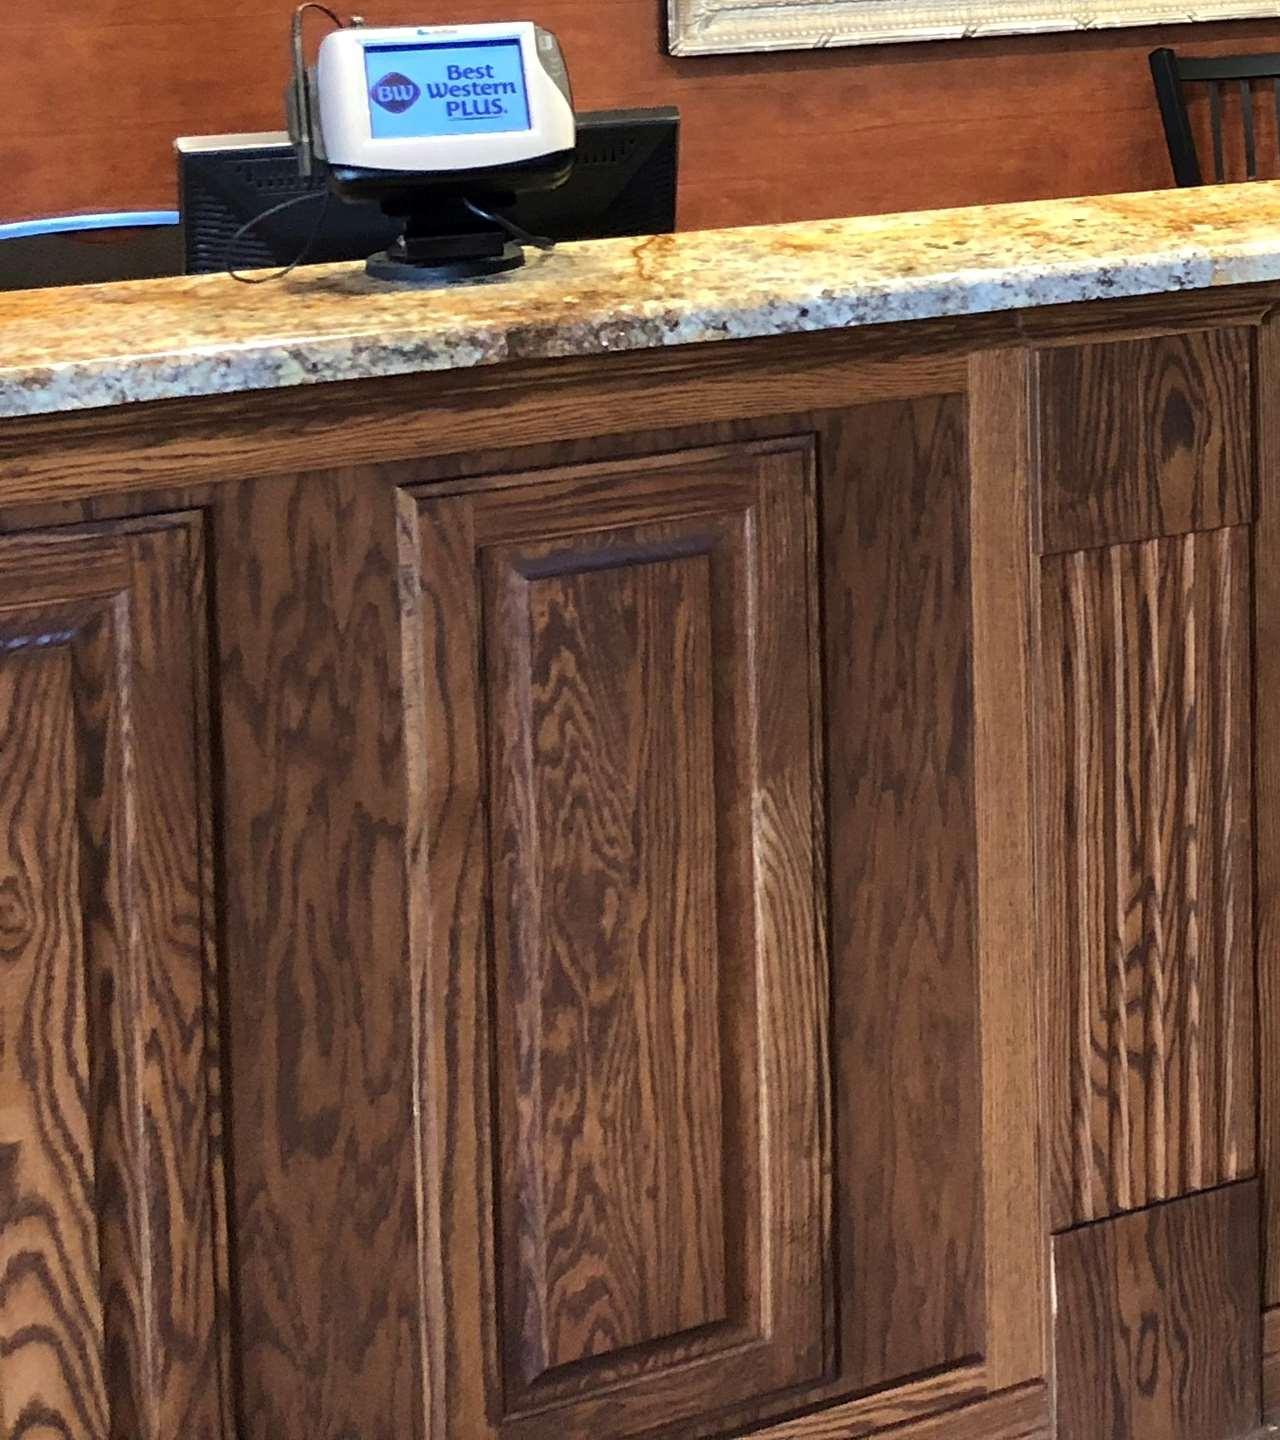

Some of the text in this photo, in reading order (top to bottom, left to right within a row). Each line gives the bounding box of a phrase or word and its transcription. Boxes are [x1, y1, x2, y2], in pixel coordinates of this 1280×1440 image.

[446, 64, 494, 81] Best
[377, 85, 415, 103] BW
[426, 81, 517, 99] Western
